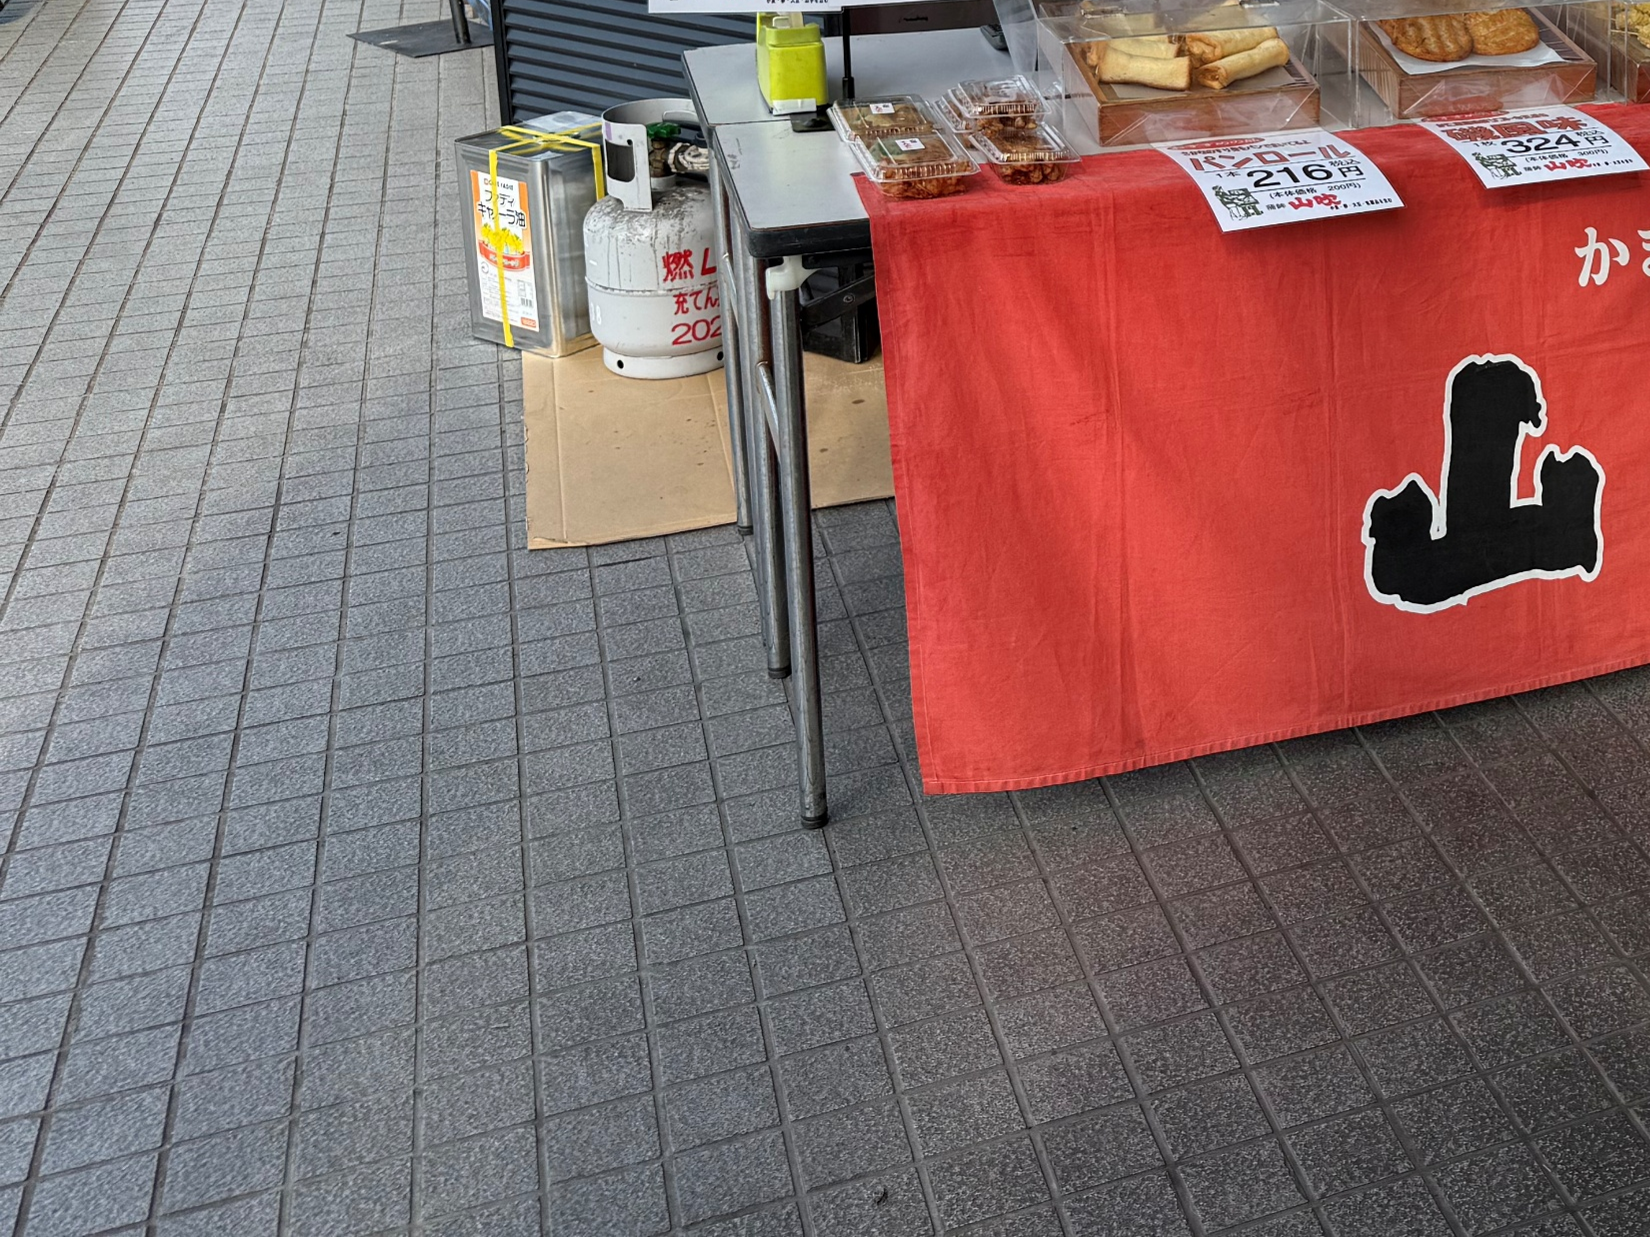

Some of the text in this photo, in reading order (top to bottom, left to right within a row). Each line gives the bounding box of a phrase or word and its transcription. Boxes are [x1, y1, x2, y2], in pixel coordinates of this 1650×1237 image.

[1501, 133, 1580, 154] 324
[1584, 136, 1610, 146] 円
[1189, 144, 1352, 171] パンロール
[1544, 158, 1592, 172] 山吹
[1247, 163, 1333, 188] 216
[1338, 165, 1364, 178] 円
[1288, 192, 1342, 210] 山吹
